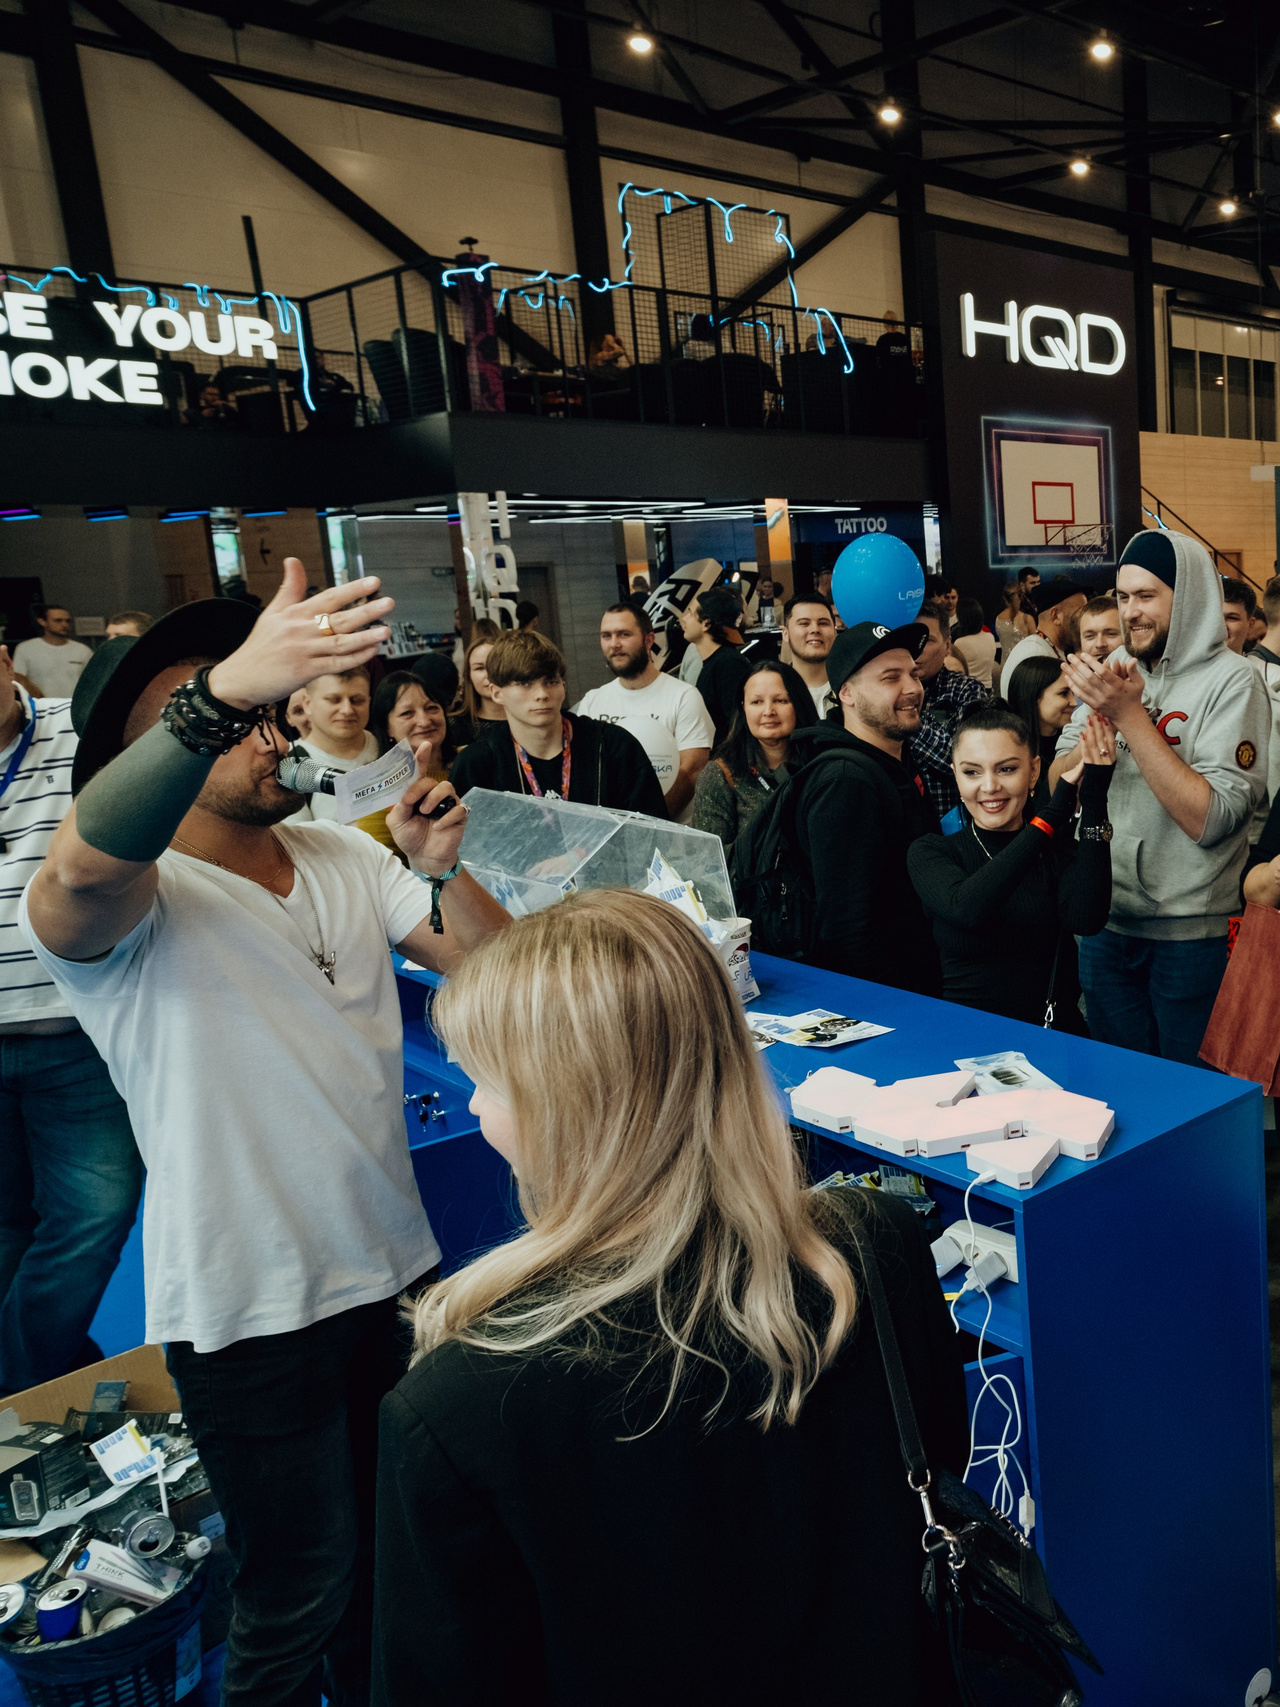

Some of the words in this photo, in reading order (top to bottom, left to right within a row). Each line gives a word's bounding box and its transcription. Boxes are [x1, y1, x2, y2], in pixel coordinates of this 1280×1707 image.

[93, 301, 279, 360] YOUR
[960, 292, 1126, 376] HQD
[834, 517, 887, 534] TATTOO
[355, 786, 376, 799] МЕГА
[96, 1563, 125, 1579] THINK
